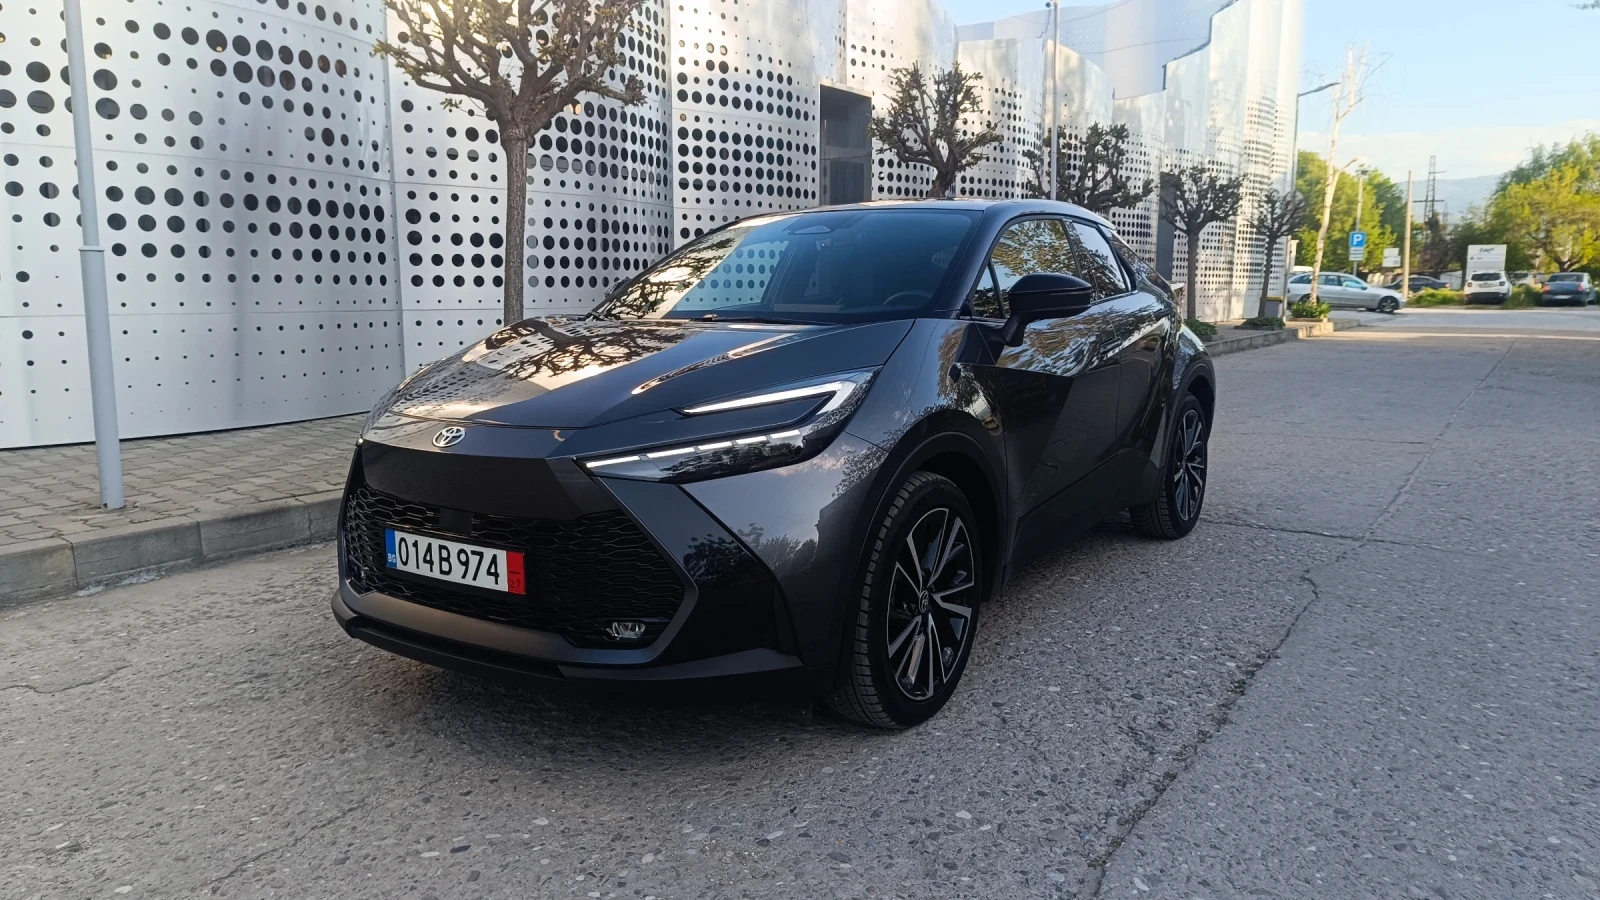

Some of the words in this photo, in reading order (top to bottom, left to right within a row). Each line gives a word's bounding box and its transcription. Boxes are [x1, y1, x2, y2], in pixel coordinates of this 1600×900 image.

[1352, 233, 1363, 246] P
[387, 553, 396, 563] BG
[398, 536, 500, 586] 014B974
[510, 578, 521, 589] 27
